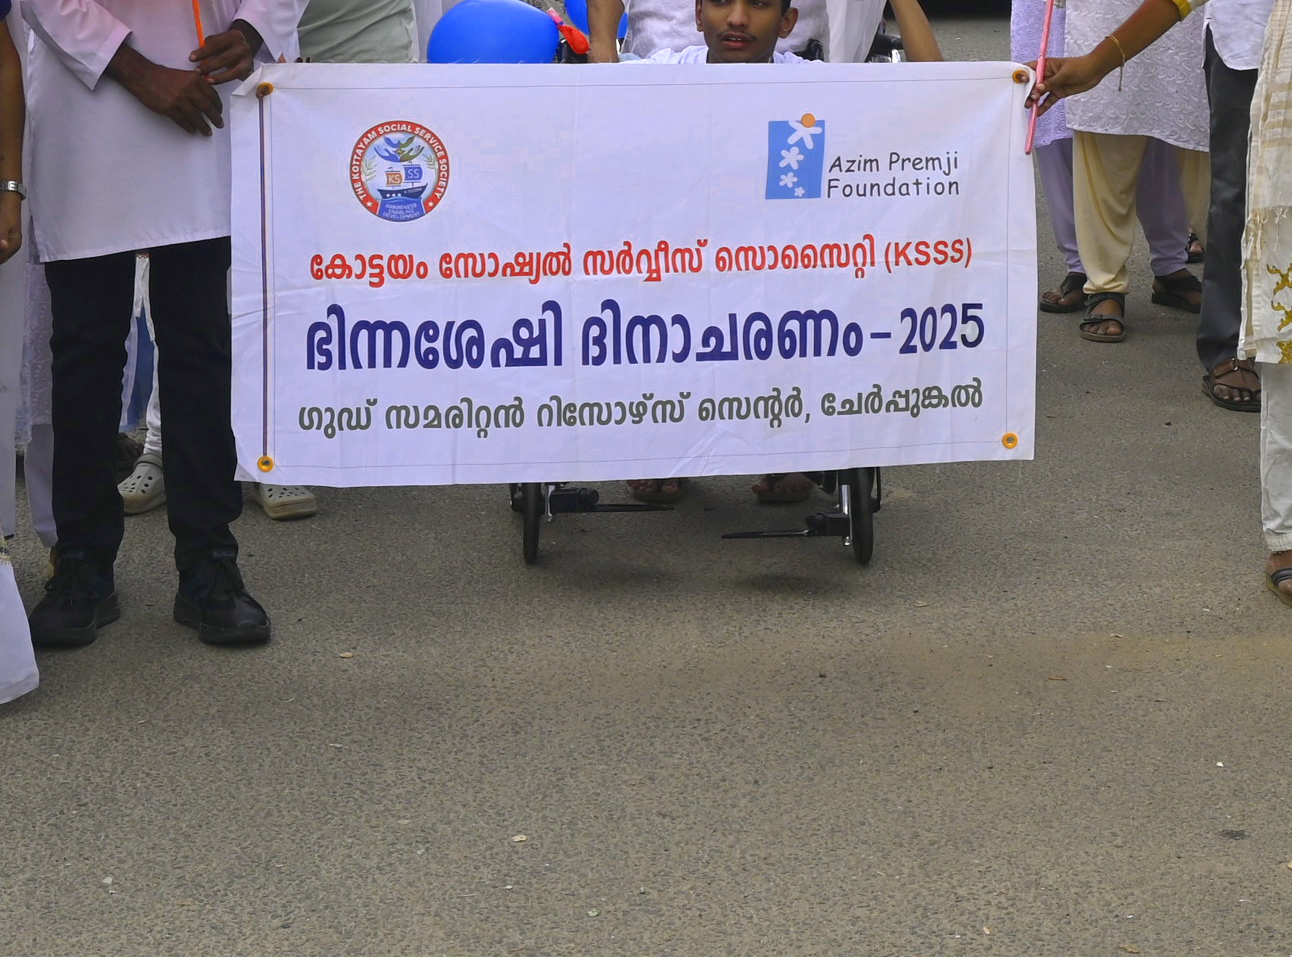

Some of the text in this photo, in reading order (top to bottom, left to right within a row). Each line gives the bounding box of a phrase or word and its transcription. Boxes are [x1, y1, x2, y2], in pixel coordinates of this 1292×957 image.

[352, 123, 447, 201] THE KOTTAYAM SOCIAL SERVICE SOCIETY
[388, 169, 420, 184] KS SS
[827, 176, 959, 198] Foundation
[828, 151, 959, 176] Azim Premji
[310, 233, 972, 288] കോട്ടയം സോഷ്യൽ സർവ്വീസ് സൊസൈറ്റി (KSSS)
[306, 299, 563, 371] ഭിന്നശേഷി
[298, 377, 983, 439] ഗുഡ് സമരിറ്റൻ റിസോഴ്സ് സെന്റർ, ചേർപ്പുങ്കൽ
